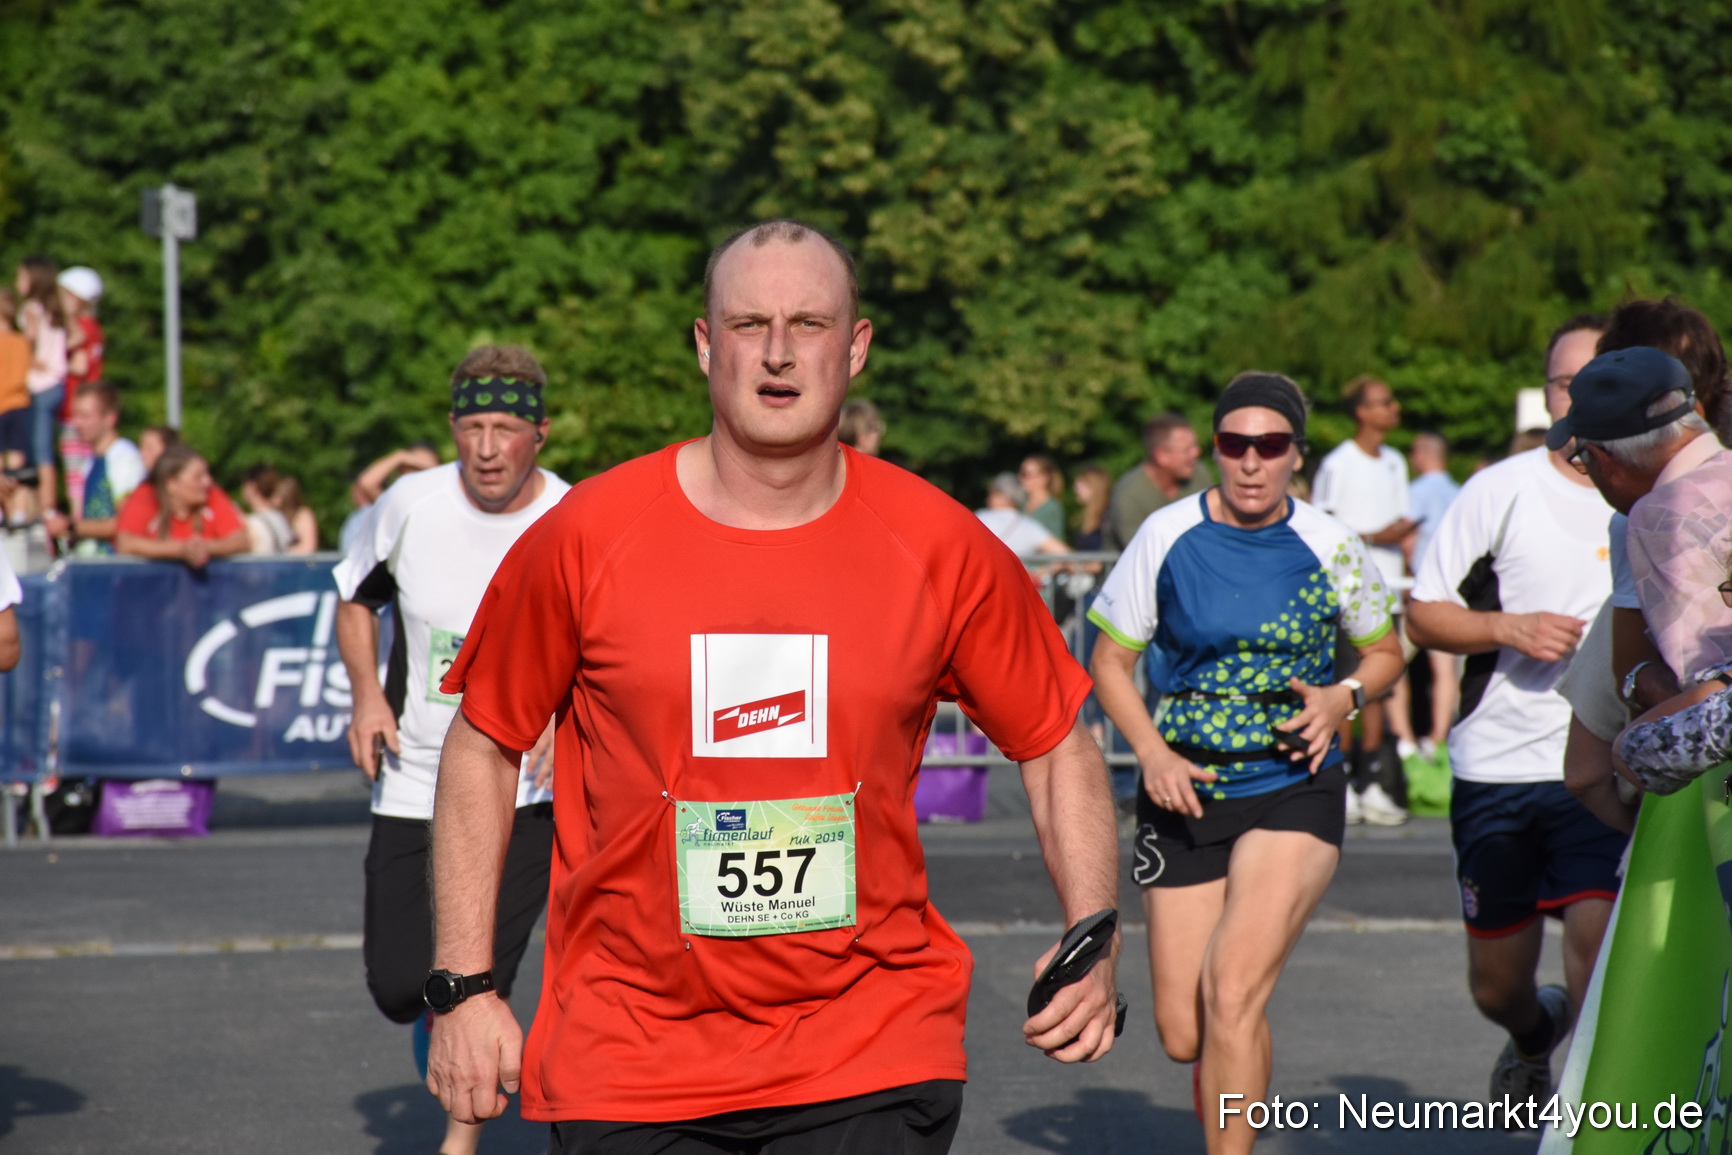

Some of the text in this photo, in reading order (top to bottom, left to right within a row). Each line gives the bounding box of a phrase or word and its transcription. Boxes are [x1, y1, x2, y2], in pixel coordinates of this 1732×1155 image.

[255, 647, 353, 708] Fis
[737, 704, 780, 729] DEHN
[283, 713, 352, 743] AU
[703, 826, 774, 842] firmenlauf
[815, 831, 844, 844] 2019
[717, 847, 817, 899] 557
[721, 896, 816, 913] Wüste Manuel
[727, 915, 755, 924] DEHN
[757, 914, 770, 922] SE
[781, 912, 793, 920] Co
[795, 911, 809, 919] KG
